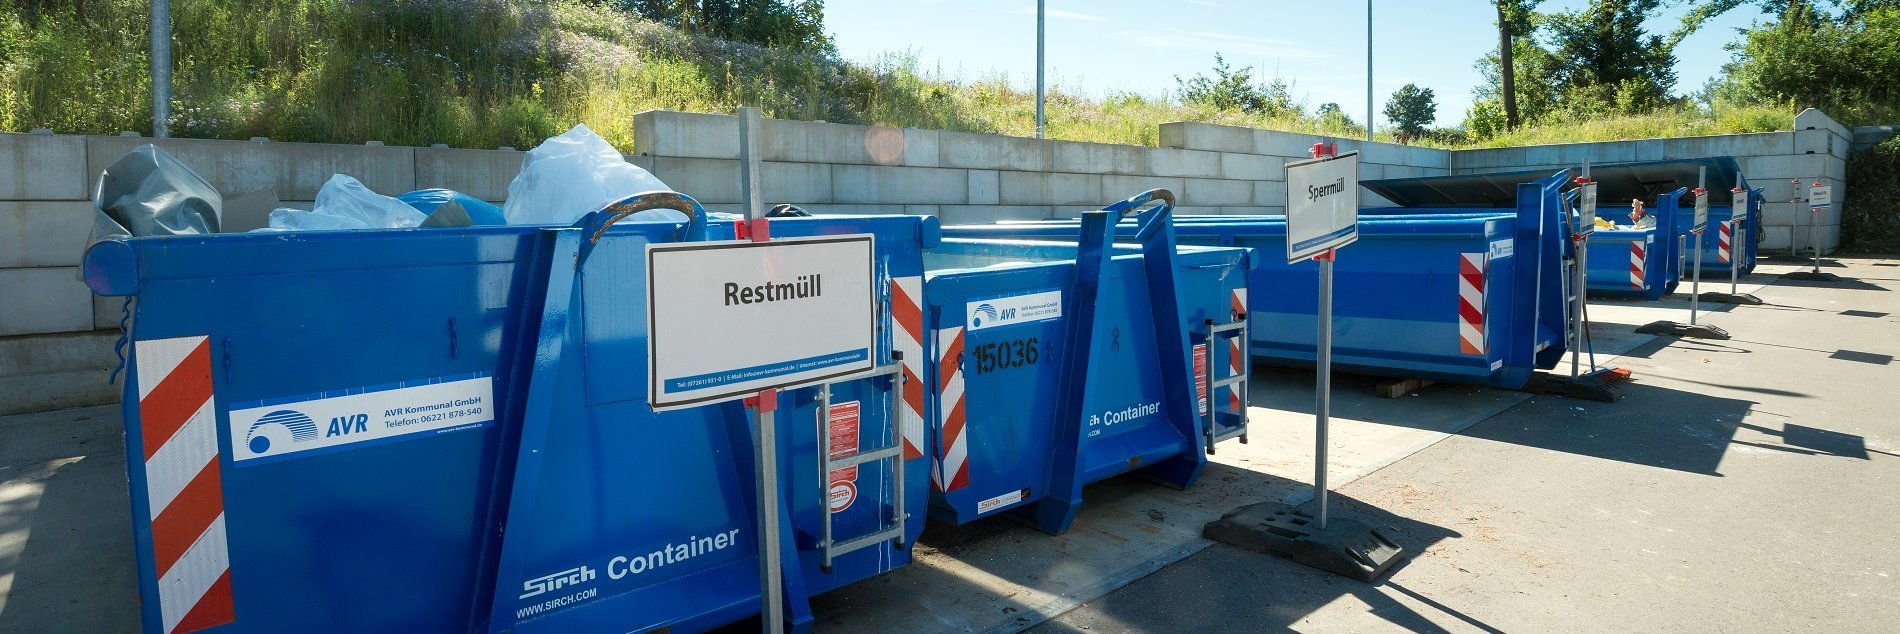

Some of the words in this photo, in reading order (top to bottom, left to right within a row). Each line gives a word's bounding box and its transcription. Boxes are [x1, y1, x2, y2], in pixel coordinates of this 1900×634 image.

[1309, 177, 1344, 202] Sperrmüll
[724, 274, 822, 306] Restmüll
[1000, 307, 1016, 321] AVR
[972, 337, 1039, 375] 15036
[384, 406, 403, 418] AVR
[405, 400, 453, 415] Kommunal
[454, 396, 482, 406] GmbH
[385, 417, 420, 429] Telefon:
[421, 413, 447, 423] 06221
[448, 407, 482, 419] 878-540
[1104, 402, 1160, 426] Container
[326, 413, 369, 438] AVR
[519, 565, 596, 600] Sirch
[607, 528, 740, 580] Container
[516, 588, 597, 619] WWW.SIRCH.COM
